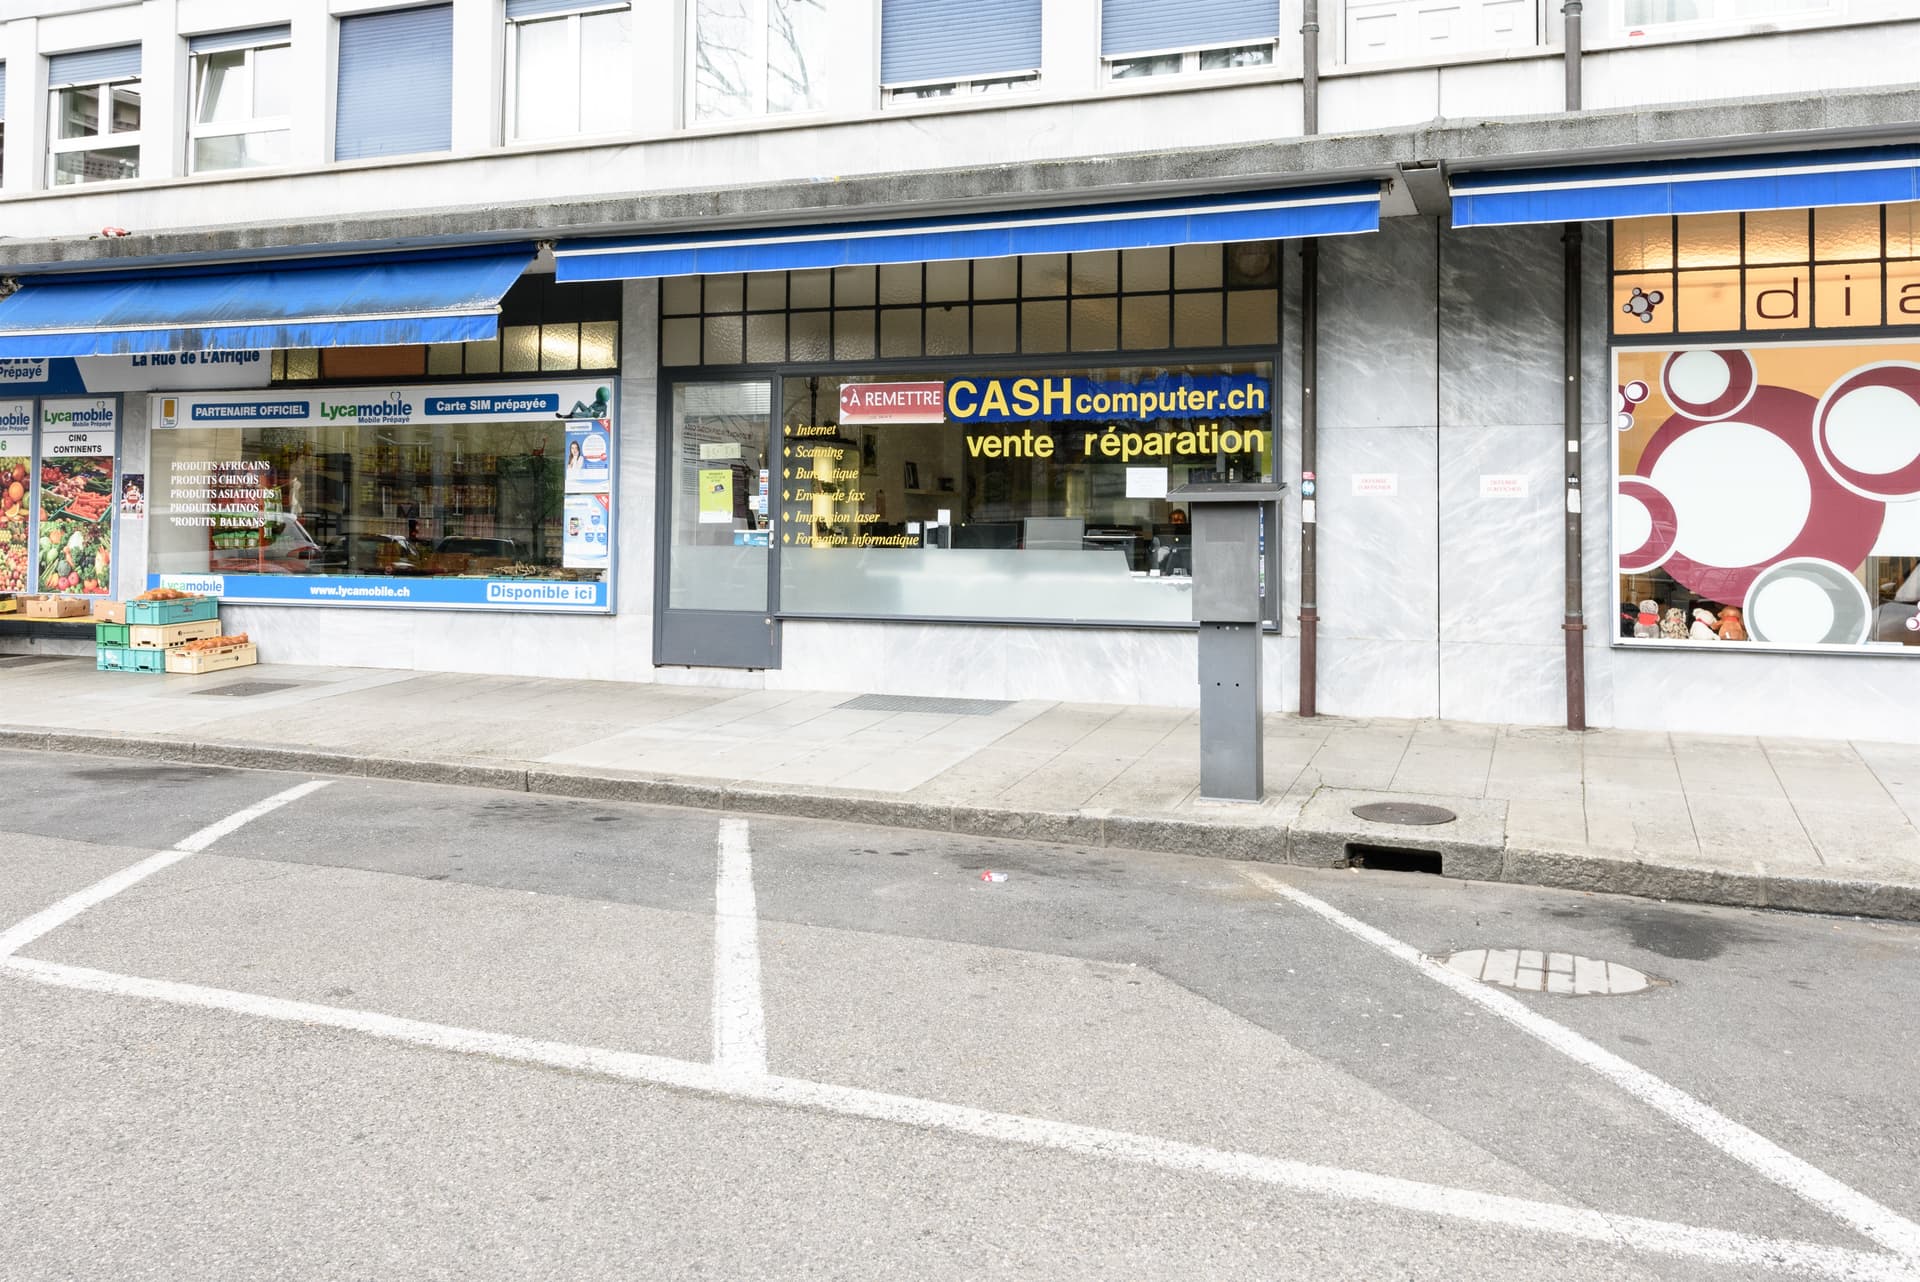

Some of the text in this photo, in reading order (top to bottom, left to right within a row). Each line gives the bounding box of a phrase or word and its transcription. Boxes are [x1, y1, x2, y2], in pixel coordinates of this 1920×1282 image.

[132, 354, 147, 367] La
[151, 354, 176, 366] Rue
[180, 351, 197, 365] de
[849, 387, 941, 406] À REMETTRE
[948, 378, 1265, 419] CASH computer.ch
[195, 405, 305, 416] PARTENAIRE OFFICIEL
[320, 400, 412, 420] Lycamobile
[436, 398, 547, 411] Carte SIM prépayée
[0, 413, 30, 426] obile
[44, 408, 113, 424] Lycamobile
[382, 415, 410, 424] Prépayé
[797, 424, 836, 435] Internet
[53, 445, 102, 453] CONTINENTS
[967, 425, 1264, 461] vente réparation
[795, 446, 843, 459] Scanning
[171, 461, 270, 470] PRODUITS AFRICAINS
[171, 475, 259, 484] PRODUITS CHINOIS
[170, 489, 274, 500] PRODUITS ASIATIQUES
[832, 489, 844, 500] de
[845, 490, 865, 502] fax
[170, 503, 259, 512] PRODUITS LATINOS
[220, 517, 265, 526] BALKANS
[854, 511, 880, 522] laser
[852, 534, 919, 547] informatique
[310, 585, 410, 597] www.lycamobile.ch
[491, 584, 593, 600] Disponible ici
